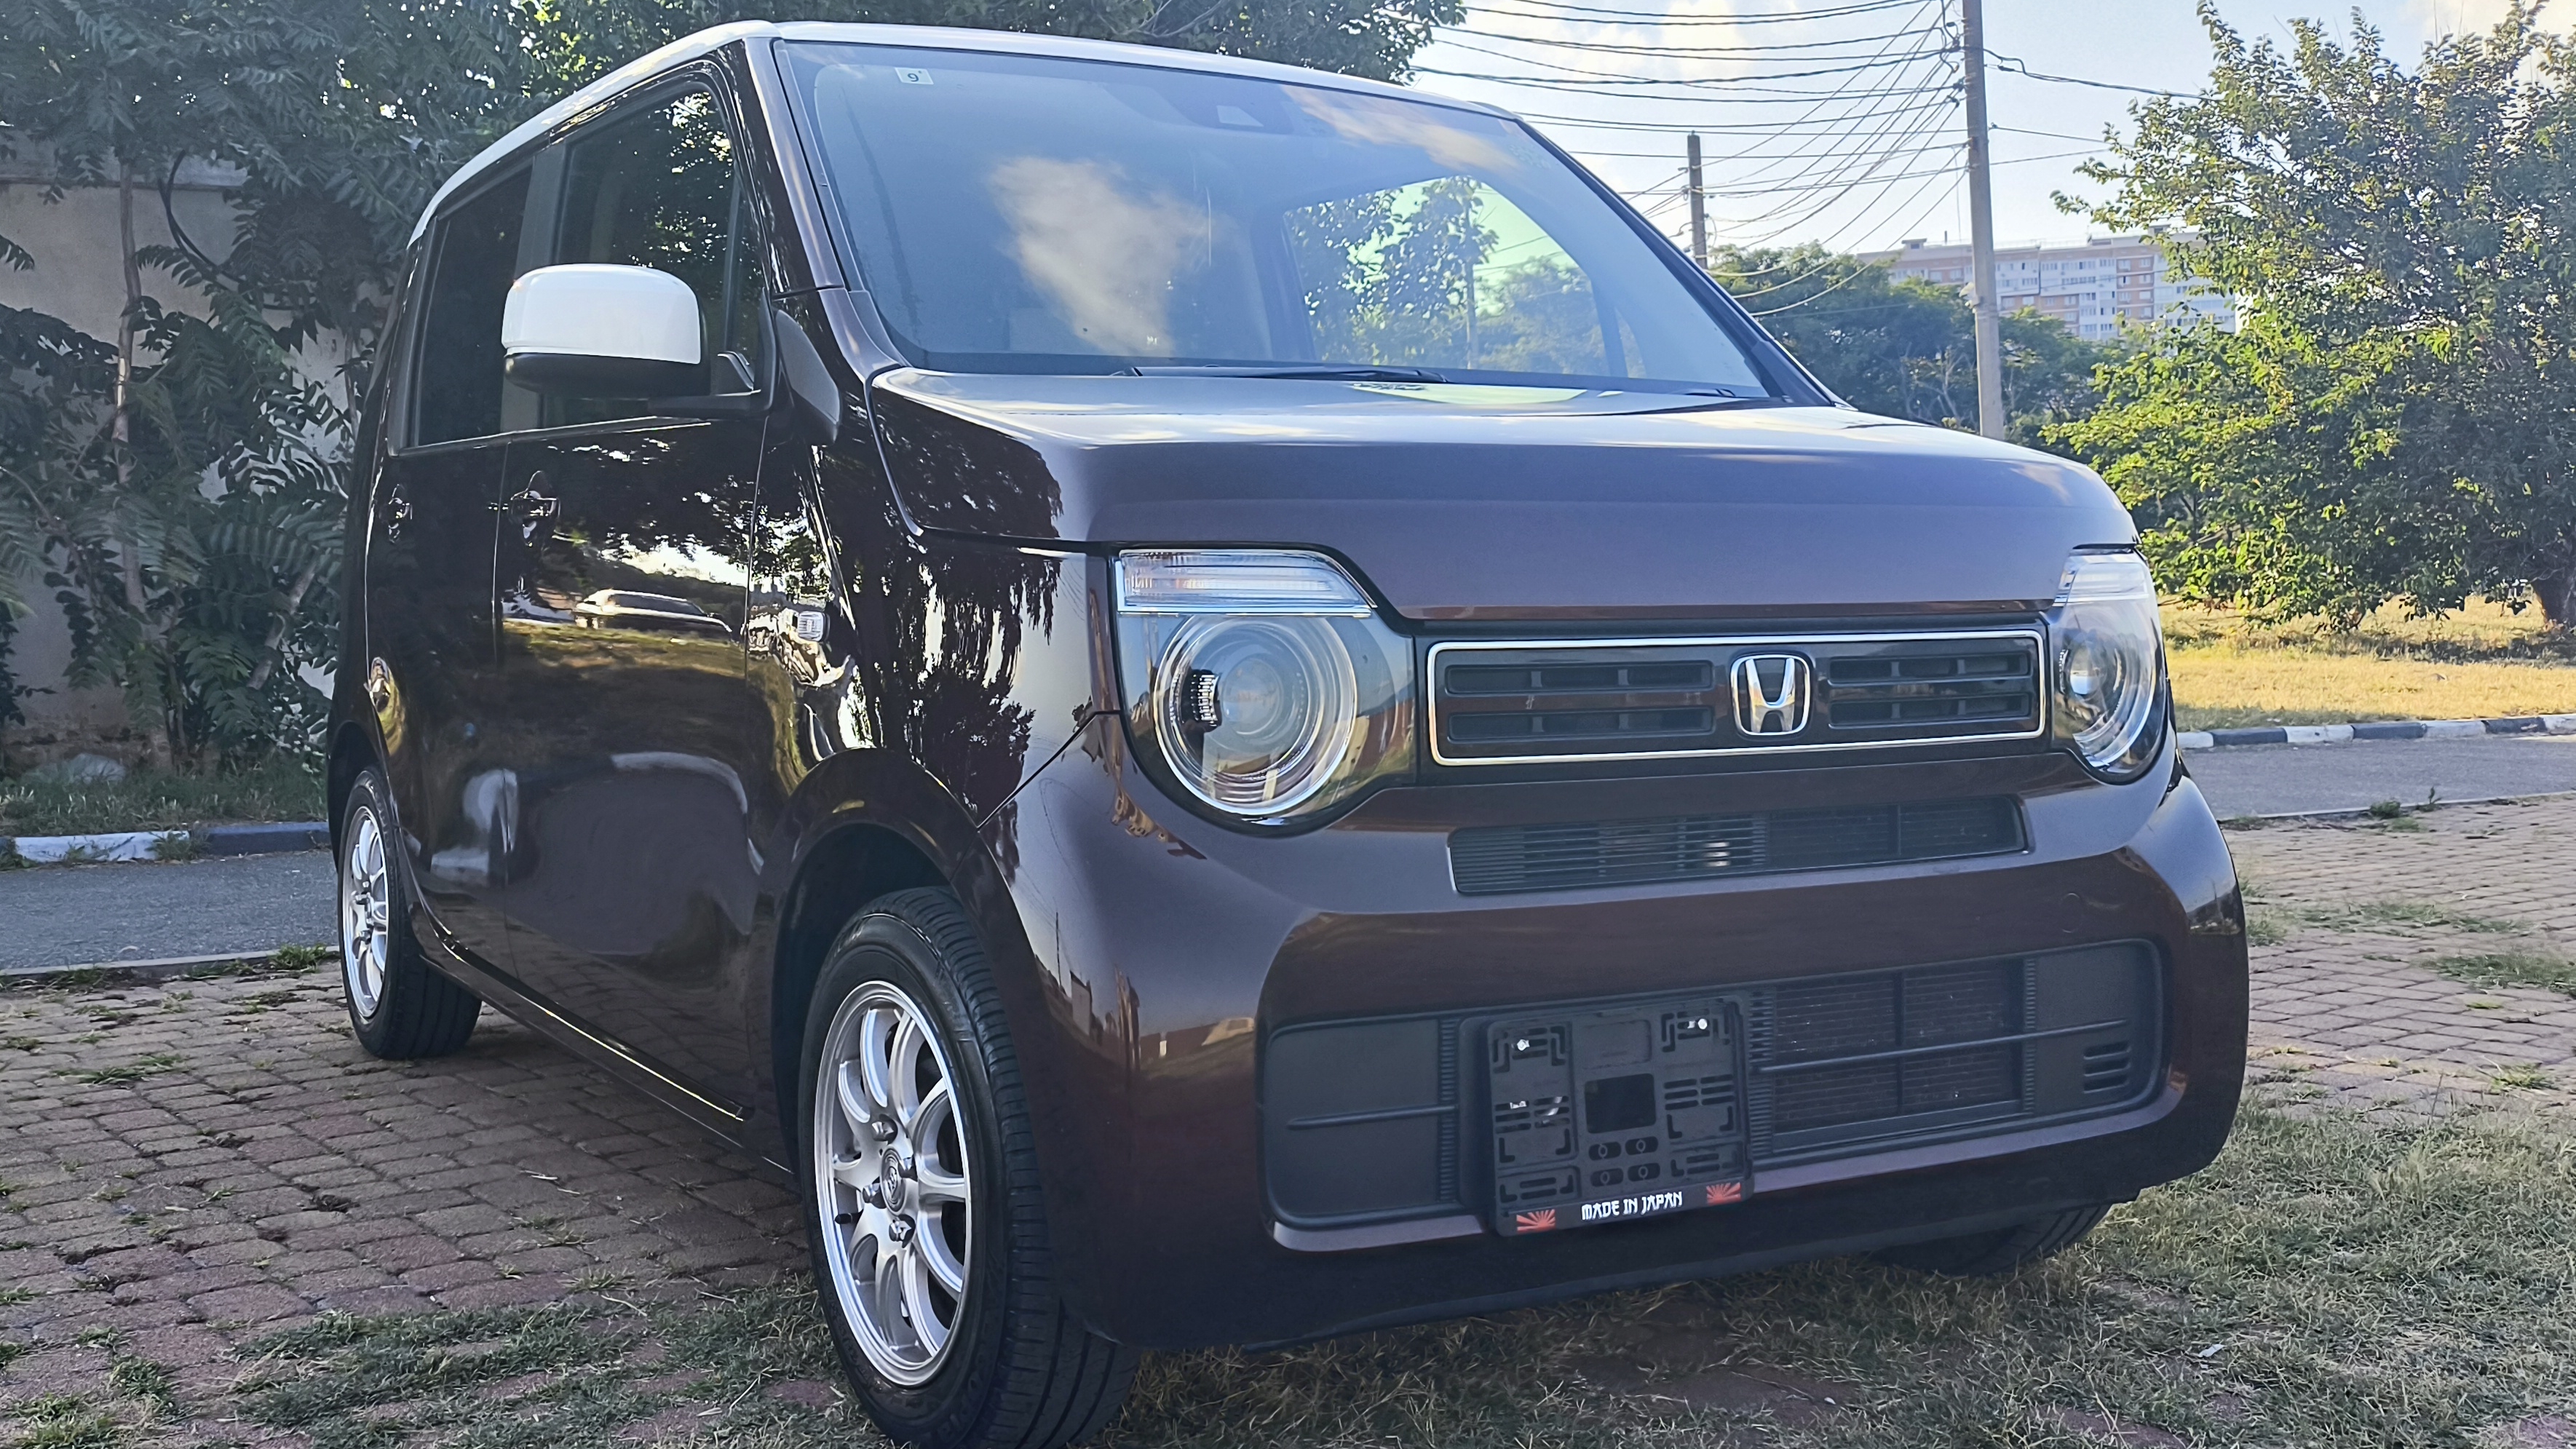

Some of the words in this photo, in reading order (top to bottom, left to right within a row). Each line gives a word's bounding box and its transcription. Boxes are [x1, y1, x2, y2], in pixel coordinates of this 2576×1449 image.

[907, 73, 919, 82] 9
[1745, 657, 1796, 734] H
[1581, 1200, 1620, 1220] MADE
[1622, 1197, 1638, 1215] IN
[1640, 1191, 1683, 1215] JAPAN
